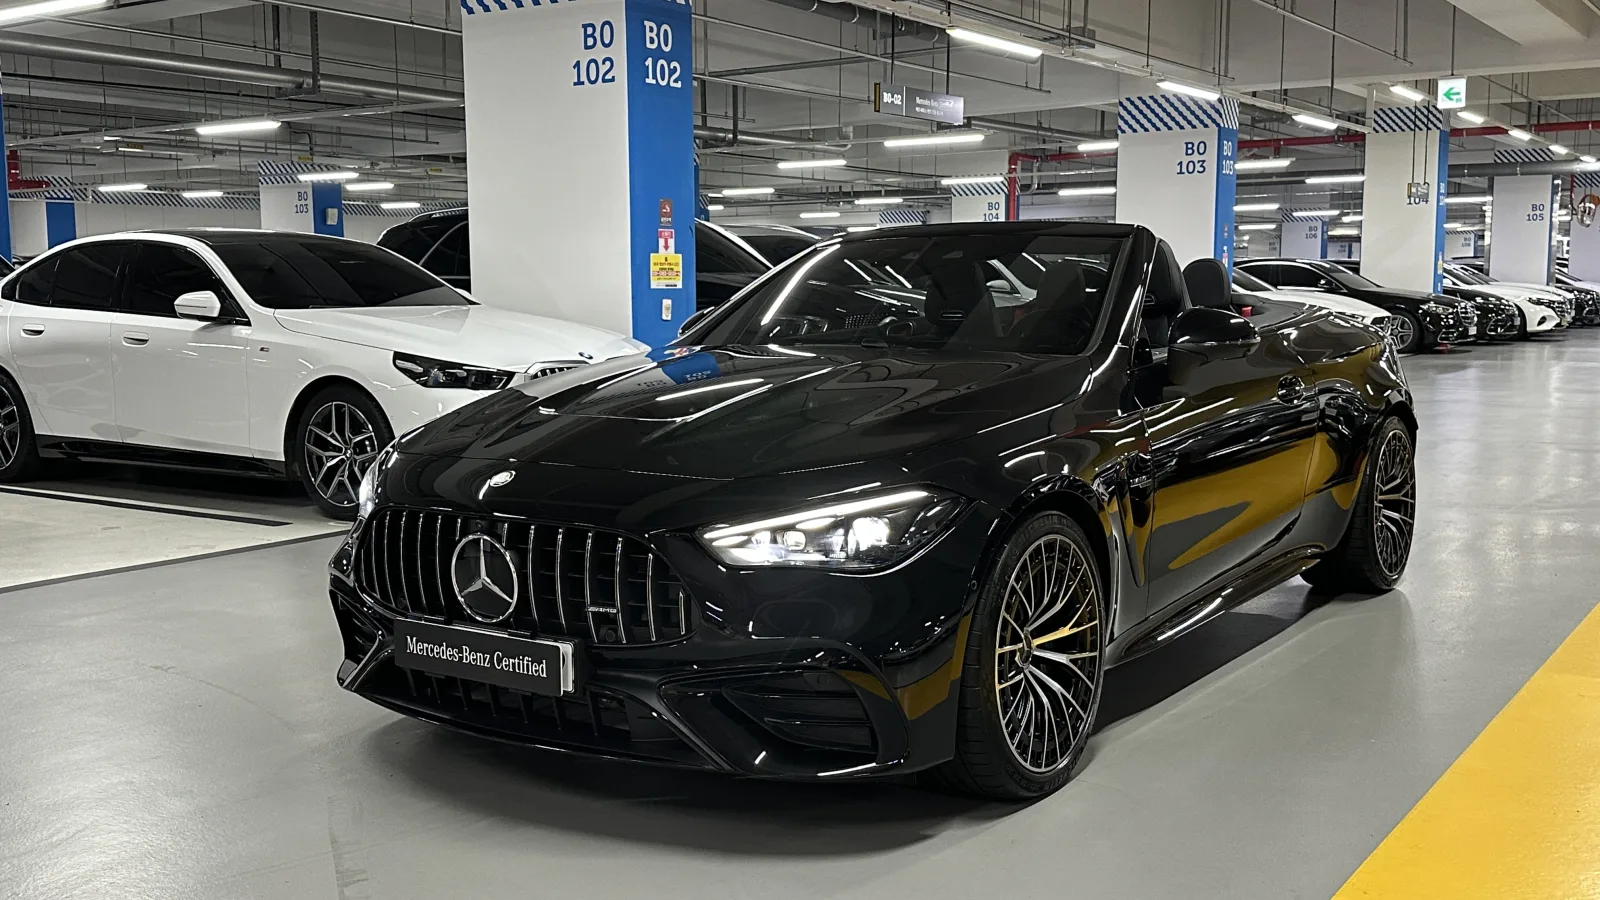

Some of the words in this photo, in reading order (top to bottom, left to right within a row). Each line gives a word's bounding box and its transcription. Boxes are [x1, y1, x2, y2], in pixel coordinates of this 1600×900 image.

[572, 56, 616, 86] 102
[644, 57, 682, 88] 102
[1176, 160, 1207, 175] 103
[1222, 160, 1234, 175] 103
[294, 203, 309, 214] 103
[983, 212, 1000, 221] 104
[1526, 213, 1544, 221] 105
[406, 635, 491, 668] Mercedes-Benz
[493, 651, 548, 678] Certified
